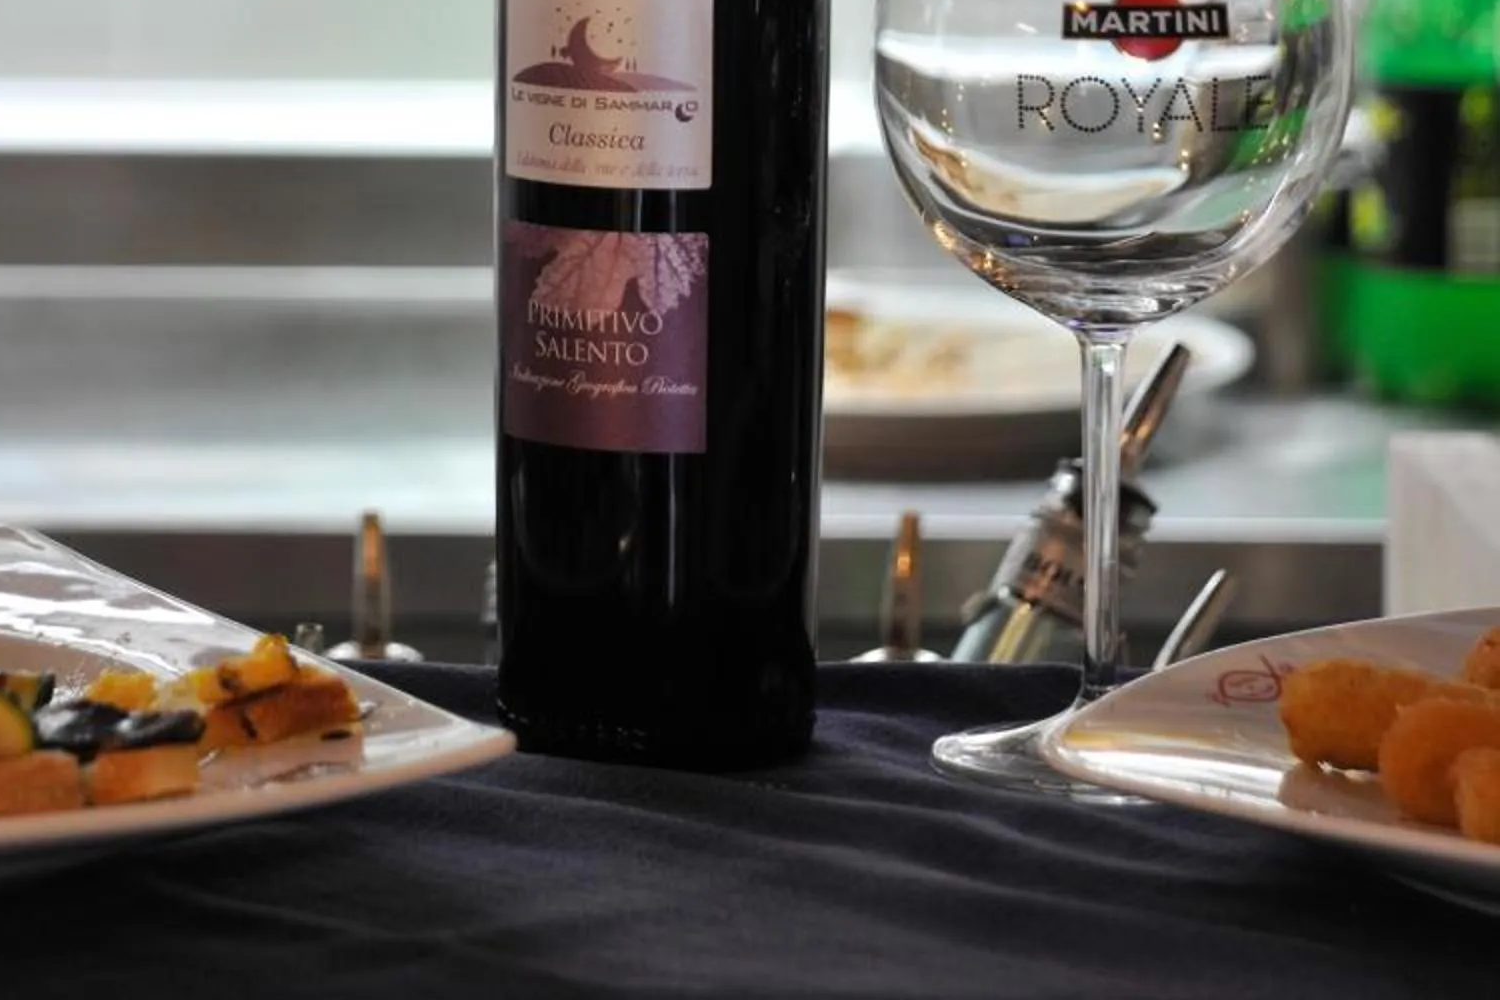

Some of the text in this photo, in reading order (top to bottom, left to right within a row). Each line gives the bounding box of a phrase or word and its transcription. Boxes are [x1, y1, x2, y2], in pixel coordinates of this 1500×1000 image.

[1070, 9, 1221, 34] MARTINI
[1016, 73, 1272, 134] ROYALE
[548, 121, 646, 151] Classica
[527, 299, 664, 335] PRIMITIVO
[534, 330, 650, 367] SALENTO
[1021, 549, 1088, 590] BOL
